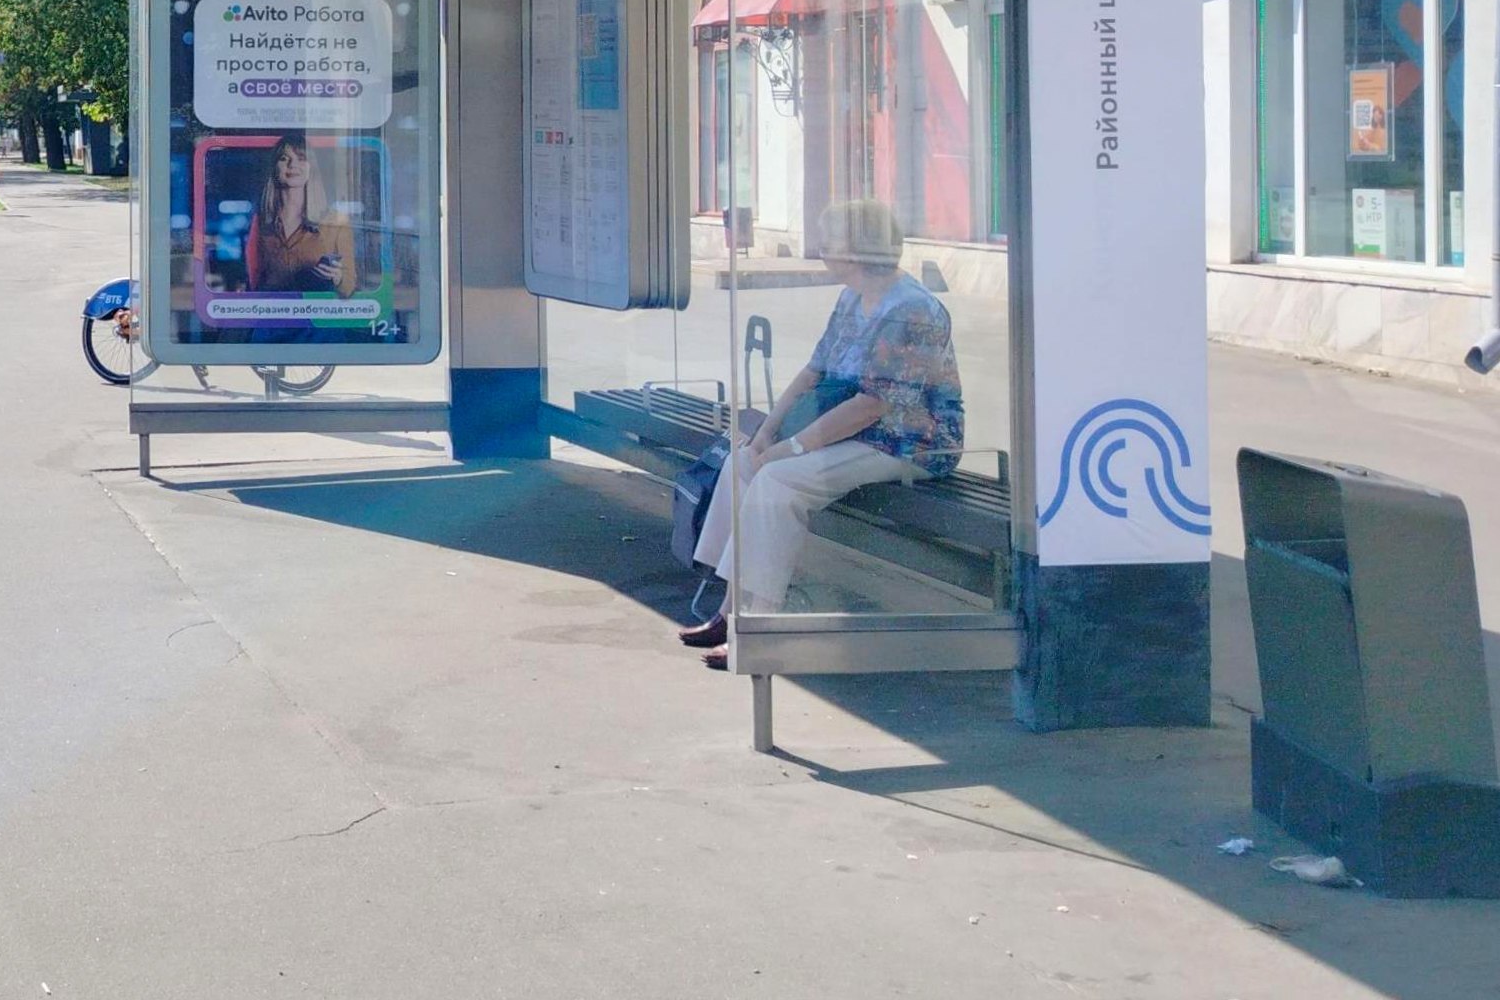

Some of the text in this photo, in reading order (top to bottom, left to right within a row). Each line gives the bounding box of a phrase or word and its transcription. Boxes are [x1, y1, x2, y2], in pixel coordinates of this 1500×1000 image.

[243, 5, 364, 22] Avito Работа
[230, 32, 357, 50] Найдётся не
[216, 57, 371, 74] просто работа,
[228, 79, 359, 94] а своё место
[1093, 18, 1119, 169] Районный
[105, 294, 122, 304] ВТБ
[212, 303, 376, 316] Разнообразие работодателей
[368, 319, 401, 336] 12+
